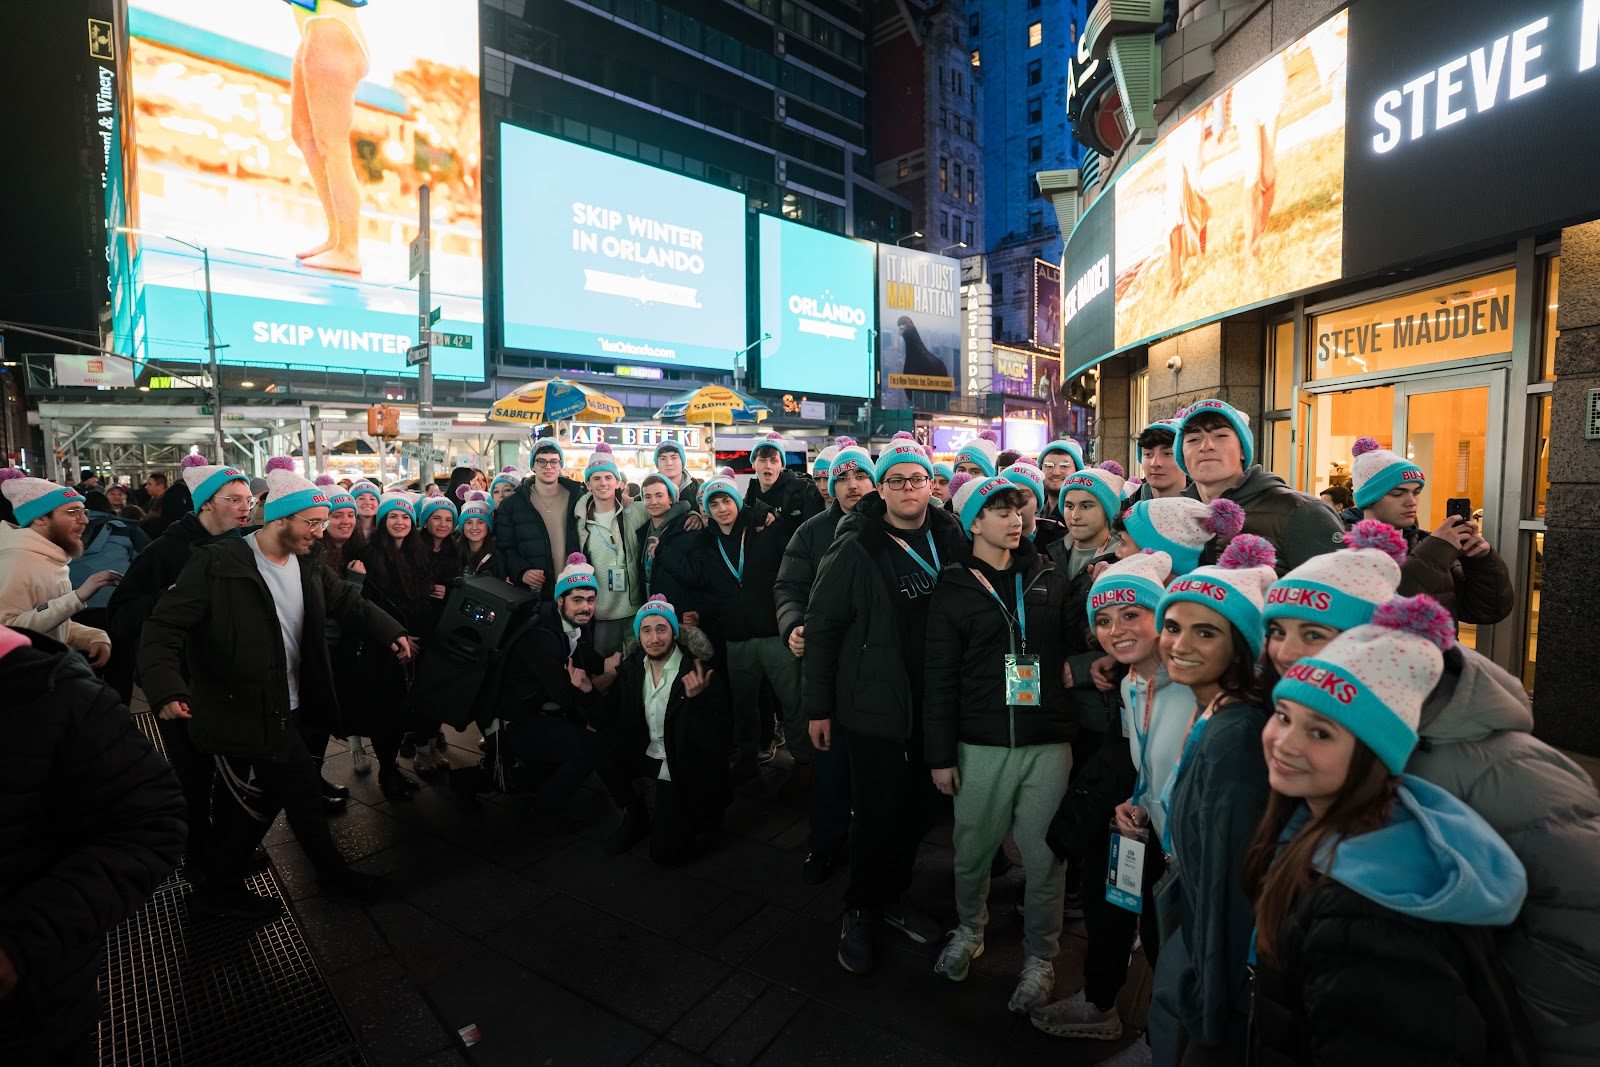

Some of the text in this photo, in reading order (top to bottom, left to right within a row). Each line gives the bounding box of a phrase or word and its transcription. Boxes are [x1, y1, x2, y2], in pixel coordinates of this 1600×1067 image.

[96, 65, 115, 113] Winery
[1373, 16, 1549, 154] STEVE
[98, 117, 113, 130] &
[572, 201, 704, 251] SKIP WINTER
[572, 228, 705, 275] IN ORLANDO
[886, 253, 954, 292] IT AIN'T JUST
[788, 294, 866, 327] ORLANDO
[886, 281, 955, 317] MANHATTAN
[252, 320, 412, 355] SKIP WINTER
[444, 334, 450, 346] W
[453, 335, 463, 347] 42
[1319, 295, 1510, 363] STEVE MADDEN
[998, 360, 1028, 378] MAGIC
[494, 408, 544, 420] SABRETT
[588, 399, 621, 414] SABRETT
[693, 401, 741, 411] SABRETT
[832, 460, 859, 476] BUCKS
[567, 575, 591, 585] BUCKS
[1169, 580, 1227, 601] BUCKS
[1091, 588, 1137, 609] BUCKS
[1267, 587, 1331, 611] BUCKS
[1285, 664, 1358, 704] BUCKS
